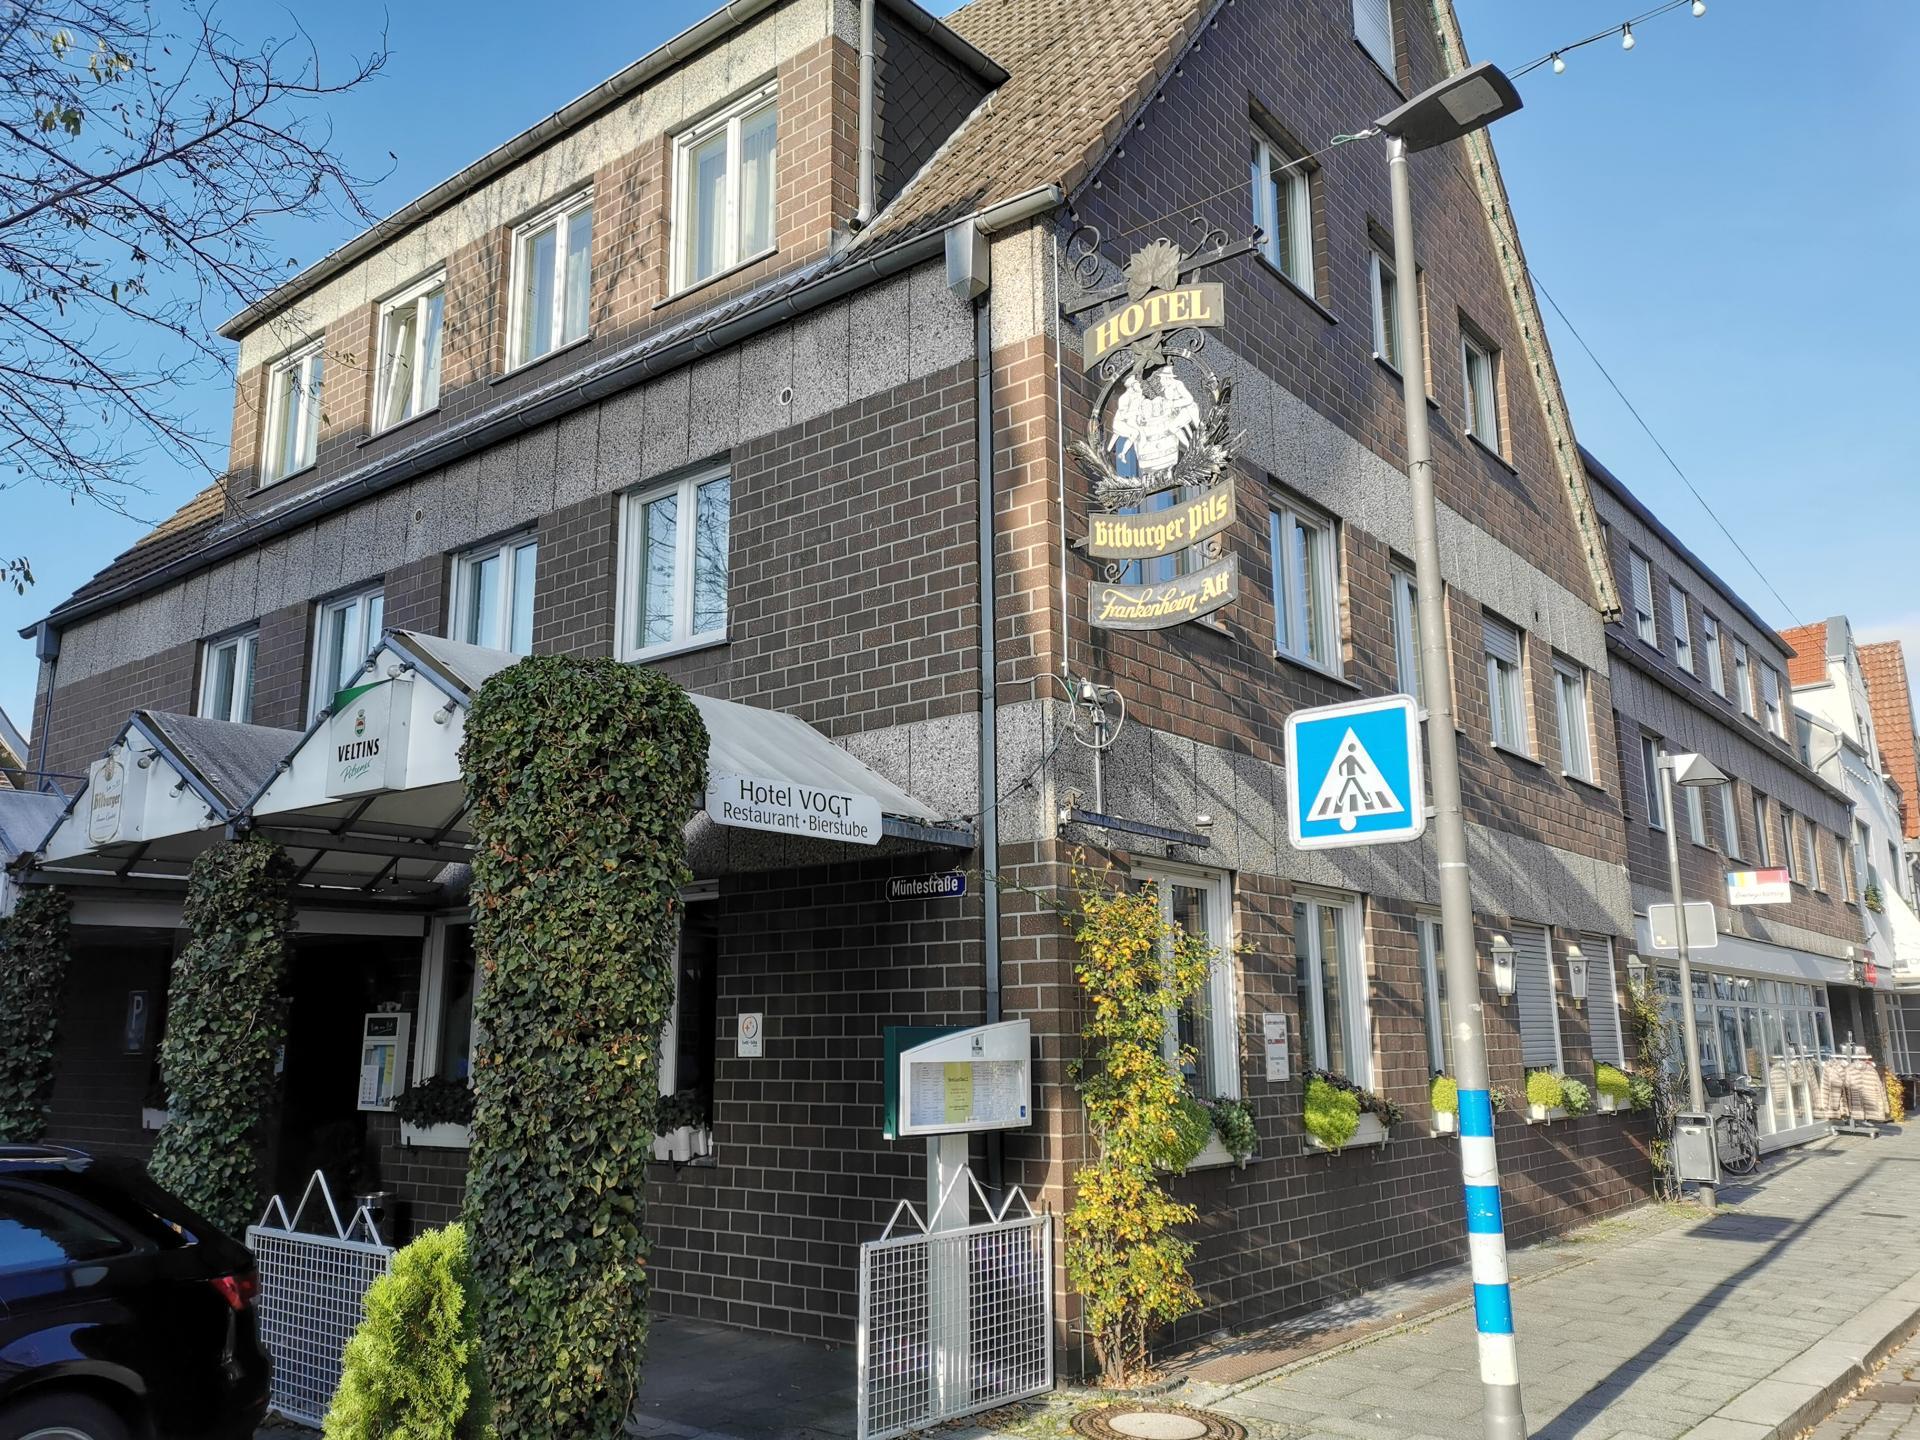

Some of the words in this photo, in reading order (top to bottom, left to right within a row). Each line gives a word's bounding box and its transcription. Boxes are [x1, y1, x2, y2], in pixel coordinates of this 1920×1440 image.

[1095, 290, 1211, 357] HOTEL
[1094, 515, 1186, 548] Bitburger
[1188, 495, 1228, 544] Pils
[1099, 588, 1197, 621] Frankenheim
[1200, 571, 1230, 600] Alt
[338, 738, 380, 763] VELTINS
[740, 779, 791, 808] Hotel
[799, 789, 852, 817] VOGT
[723, 801, 800, 829] Restaurant
[809, 816, 868, 839] Bierstube
[891, 876, 959, 896] Müntestraße
